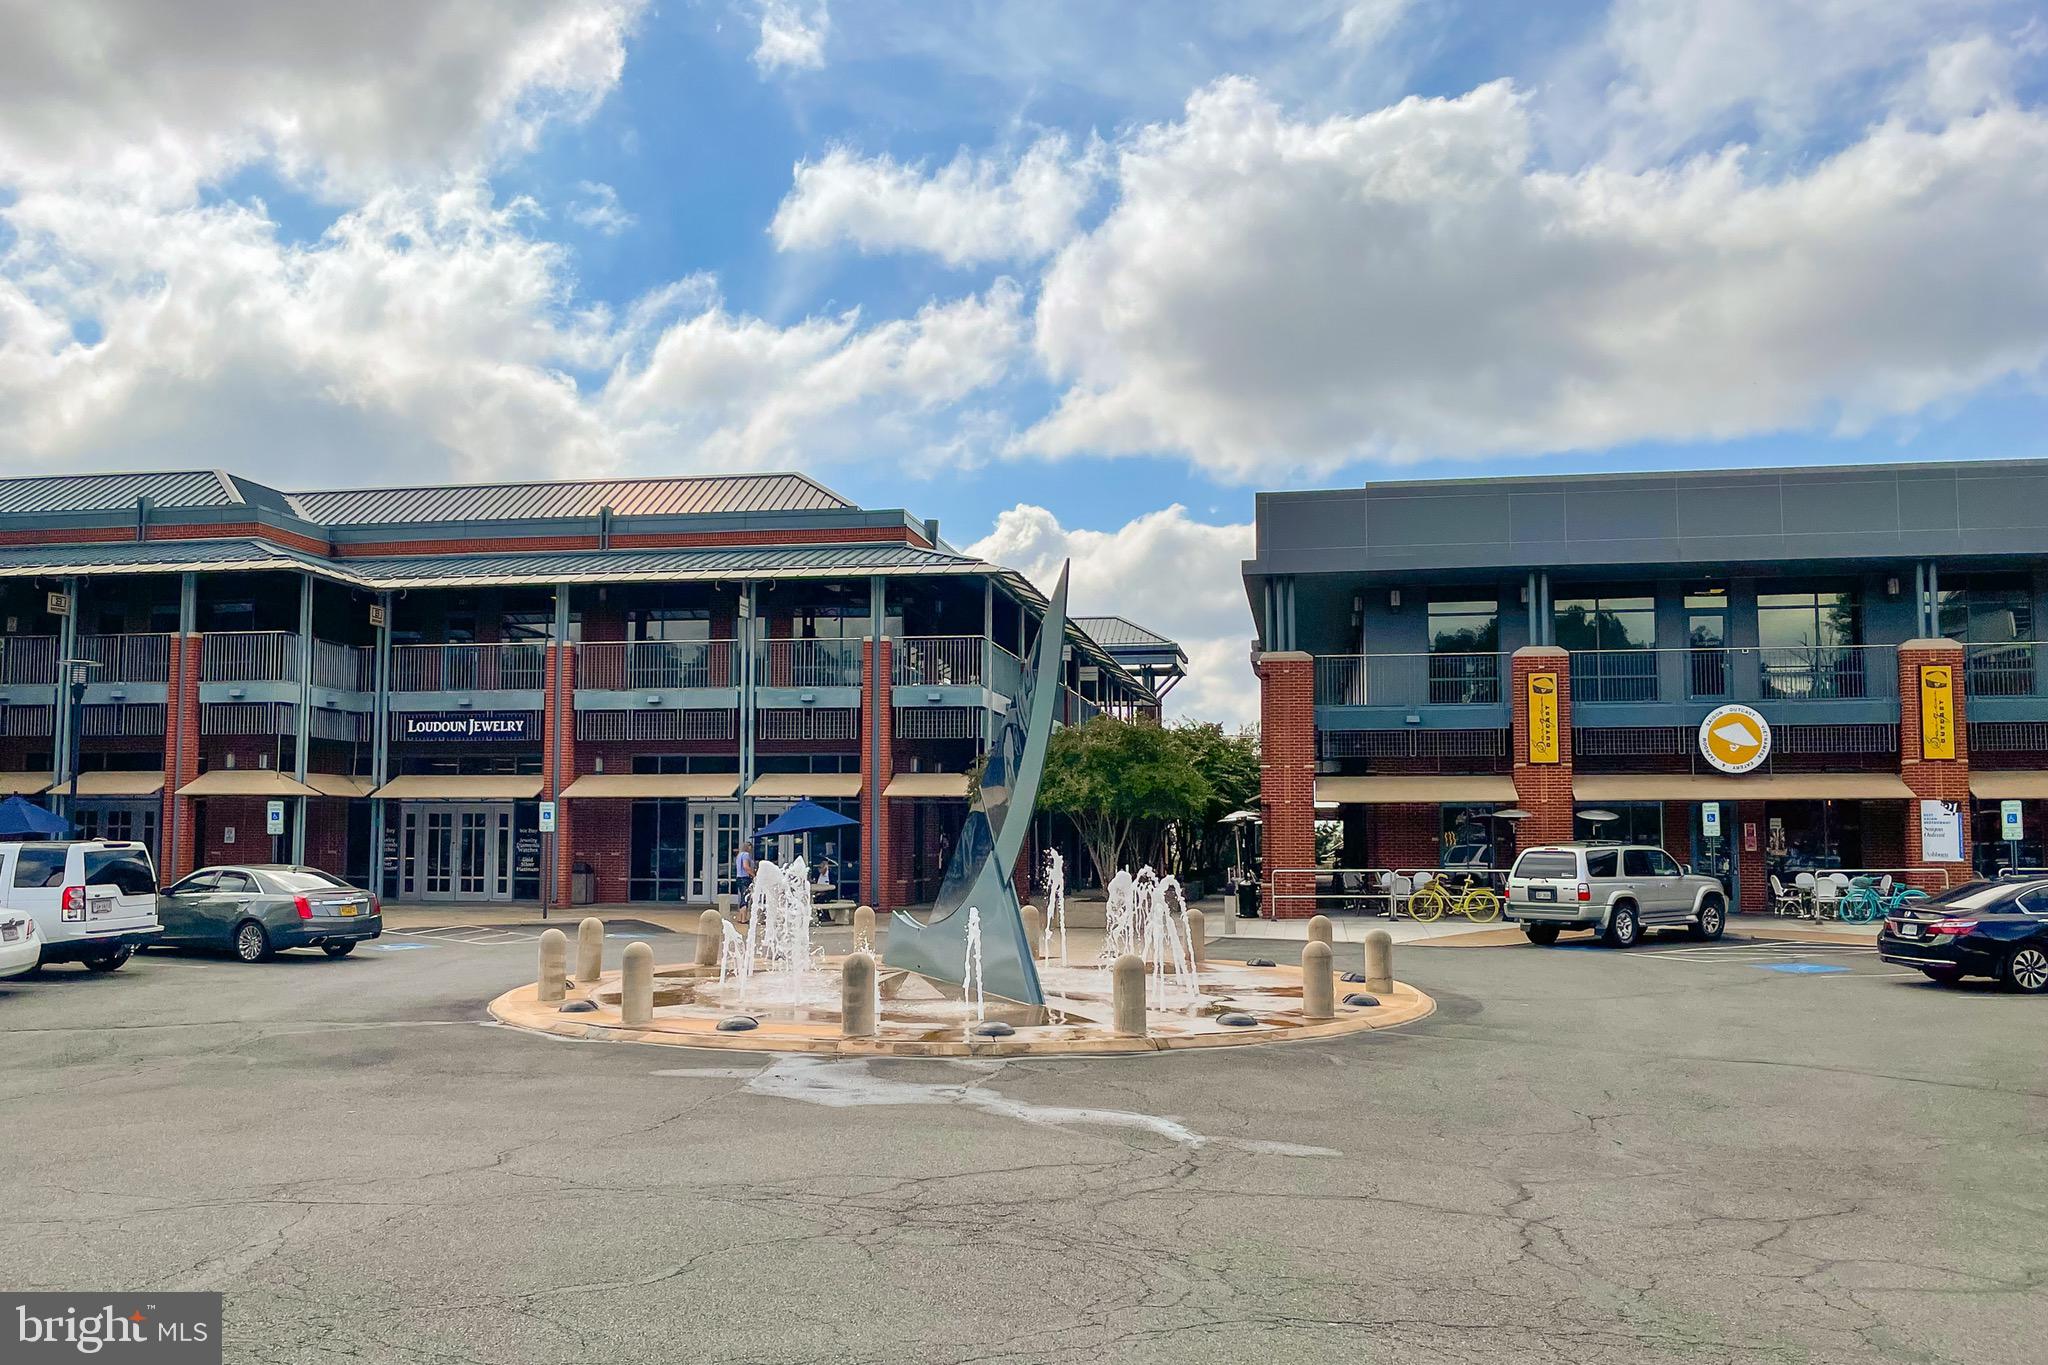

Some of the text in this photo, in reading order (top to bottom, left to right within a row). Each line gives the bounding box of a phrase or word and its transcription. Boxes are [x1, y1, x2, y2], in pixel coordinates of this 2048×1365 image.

[1728, 707, 1756, 718] OUTCAST
[407, 718, 525, 736] LOUDOUN JEWELRY
